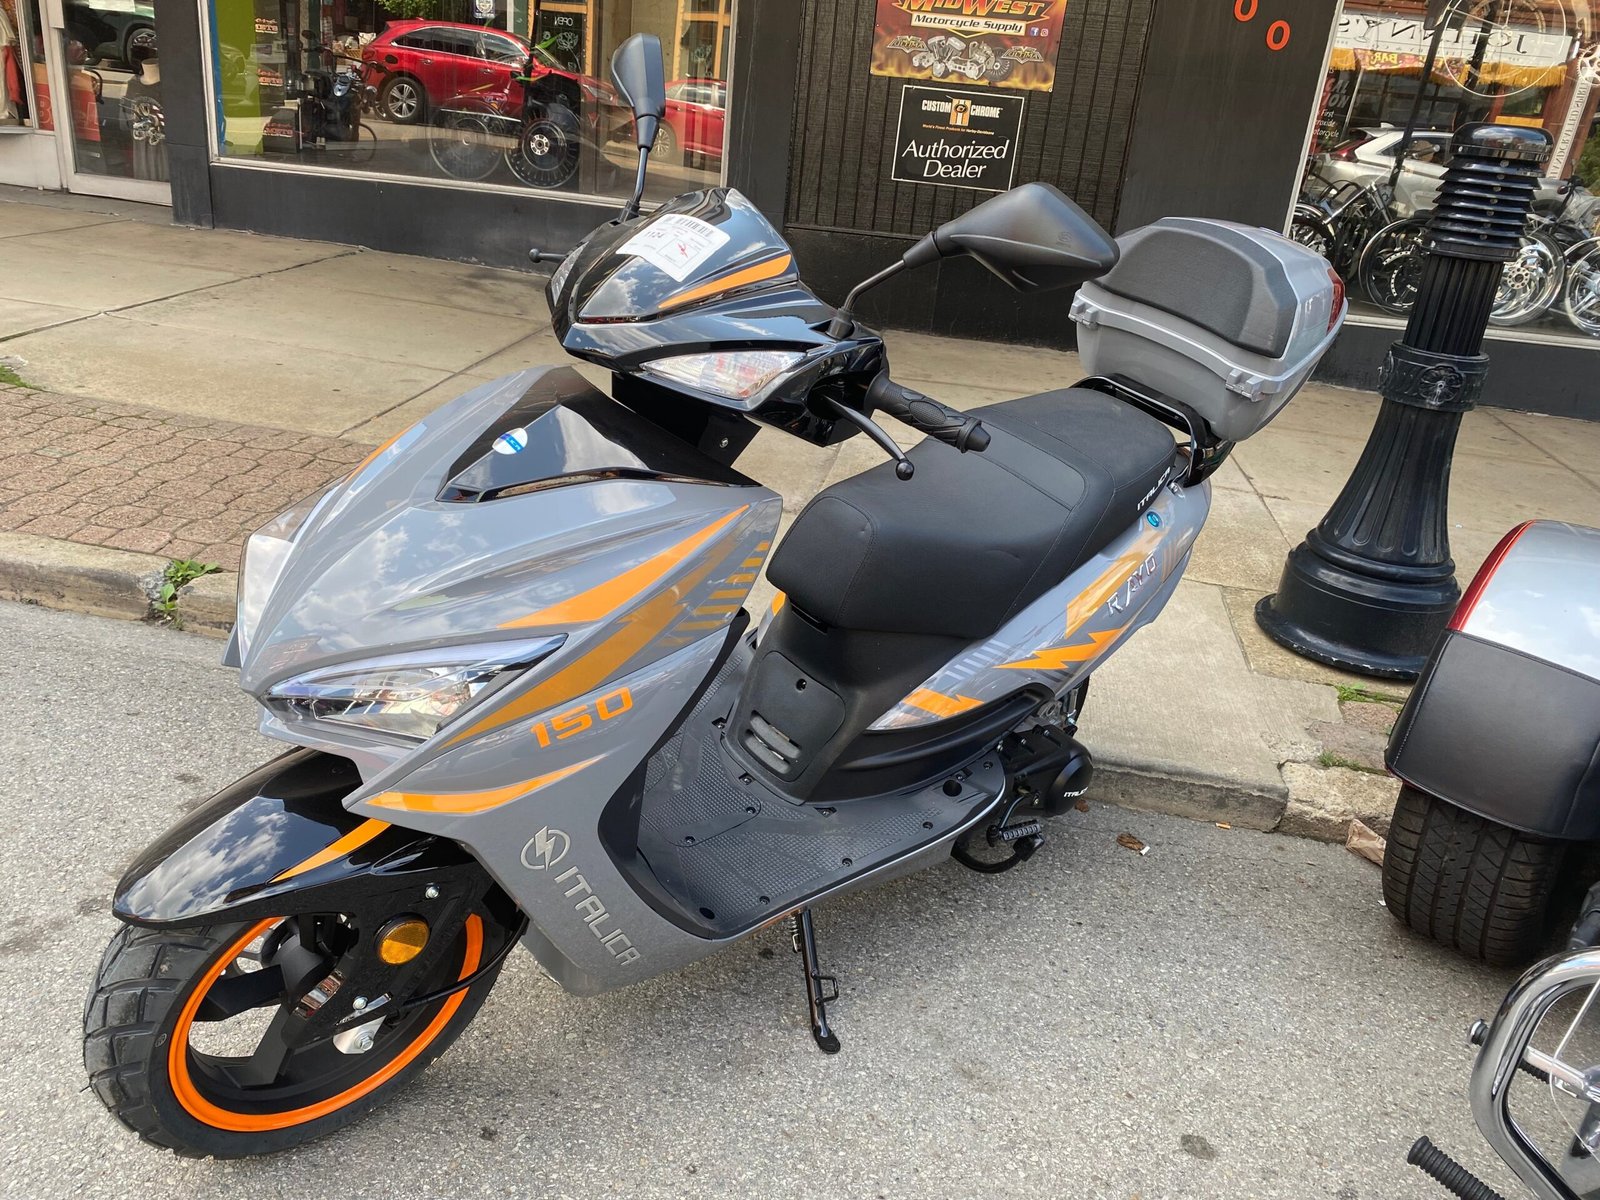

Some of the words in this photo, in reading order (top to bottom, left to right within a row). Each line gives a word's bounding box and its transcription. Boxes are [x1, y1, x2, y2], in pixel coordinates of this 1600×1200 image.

[914, 14, 980, 28] Motorcycle
[983, 20, 1023, 33] Supply
[921, 99, 951, 112] CUSTOM
[902, 138, 1010, 160] Authorized
[923, 159, 987, 179] Dealer
[1105, 552, 1158, 617] RAYO
[530, 686, 634, 749] 150
[554, 866, 640, 965] ITALICA
